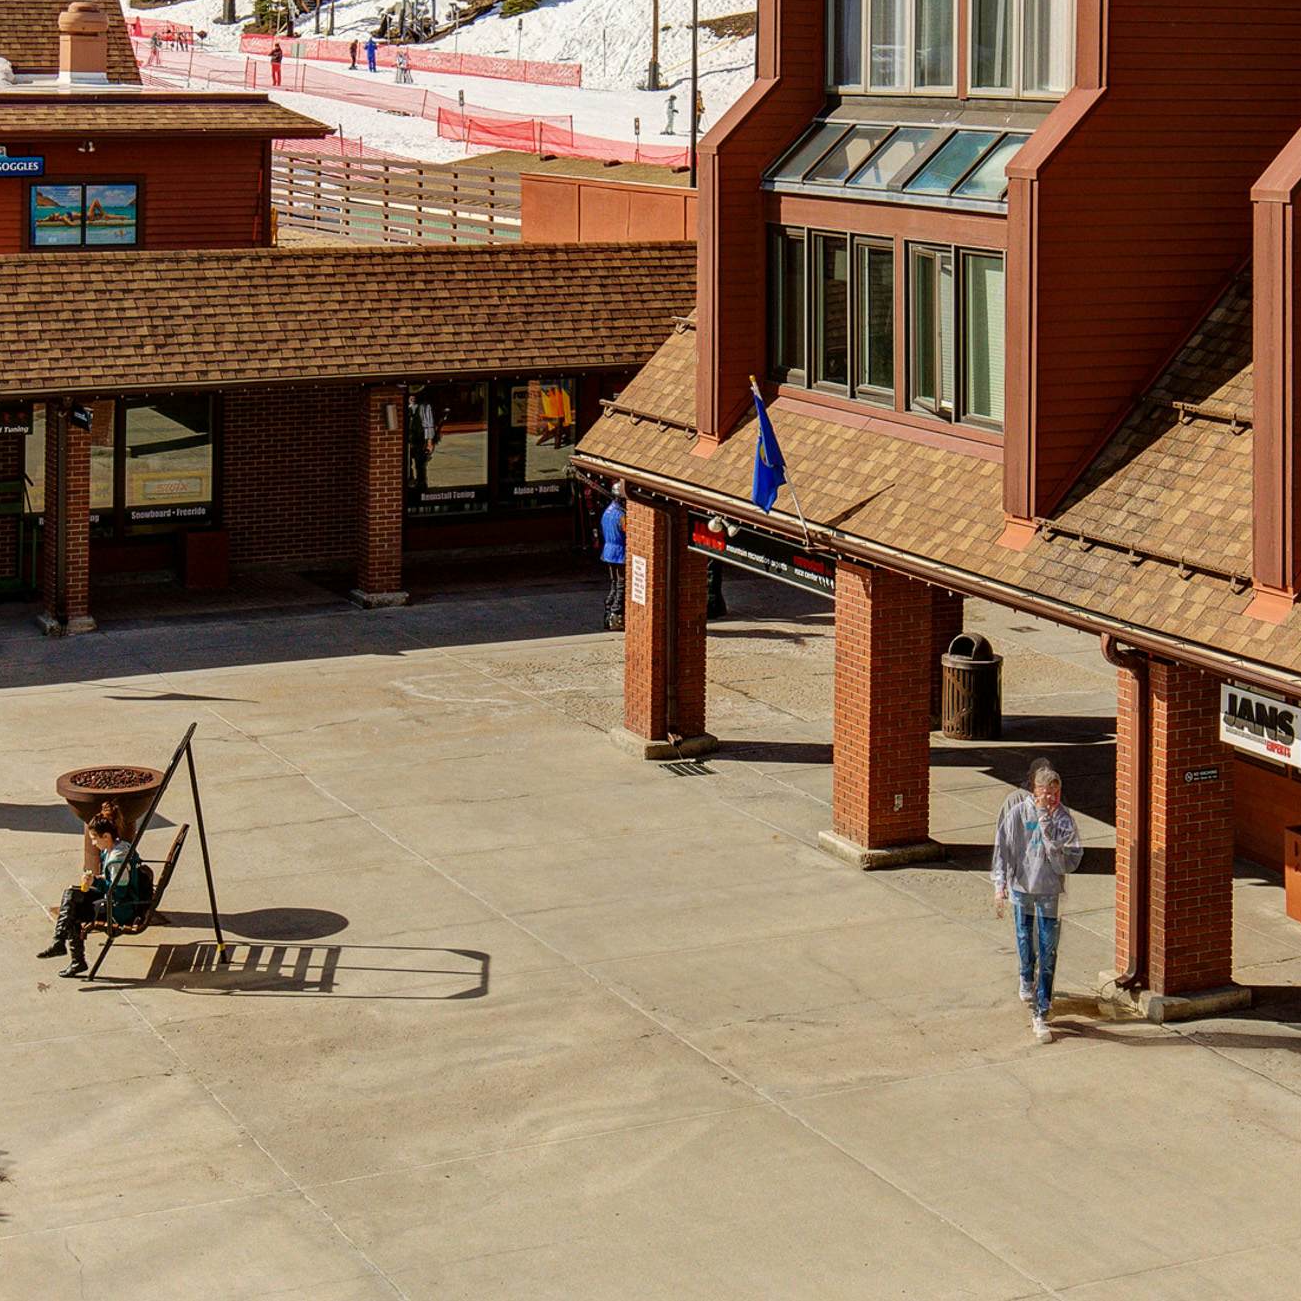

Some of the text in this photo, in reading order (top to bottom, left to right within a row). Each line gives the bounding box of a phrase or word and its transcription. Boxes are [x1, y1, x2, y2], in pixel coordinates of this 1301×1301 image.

[4, 425, 29, 435] Tuning
[131, 508, 172, 520] Snowboard
[1223, 693, 1295, 746] JANS
